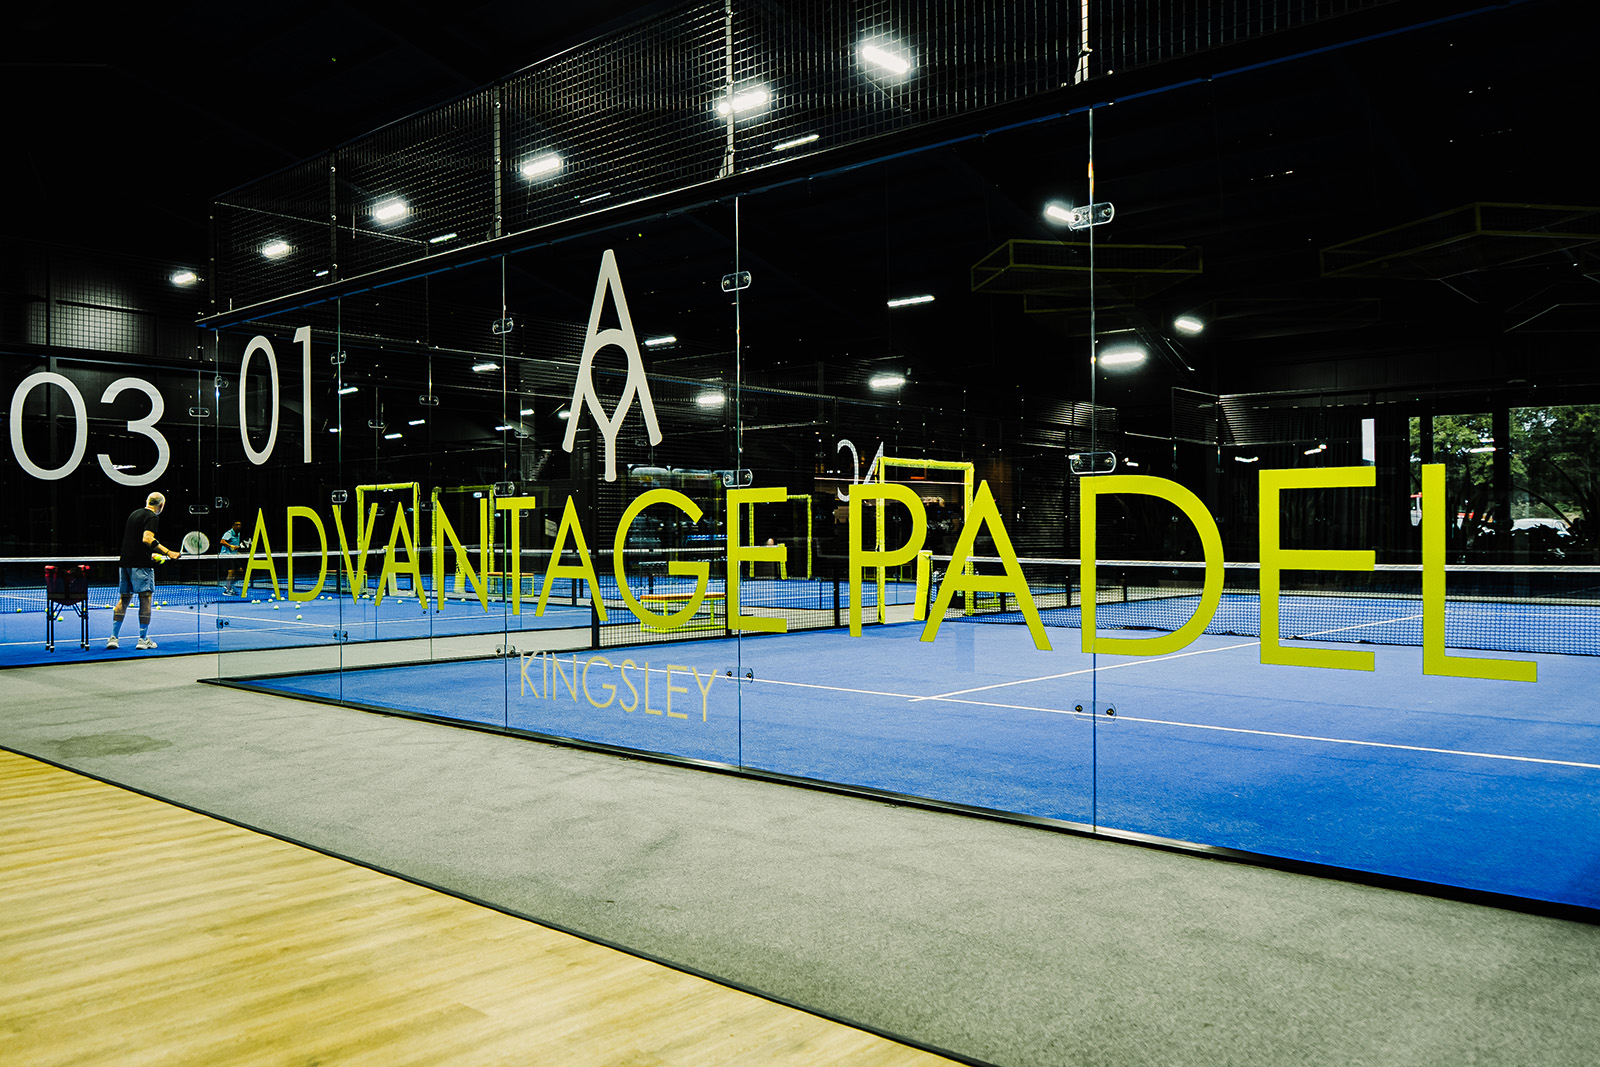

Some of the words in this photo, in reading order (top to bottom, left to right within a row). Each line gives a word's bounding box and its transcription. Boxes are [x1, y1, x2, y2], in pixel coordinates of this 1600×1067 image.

[9, 371, 171, 486] 03
[239, 325, 312, 466] 01
[240, 487, 789, 635] ADVANTAGE
[849, 463, 1538, 683] PADEL
[519, 650, 718, 722] KINGSLEY
